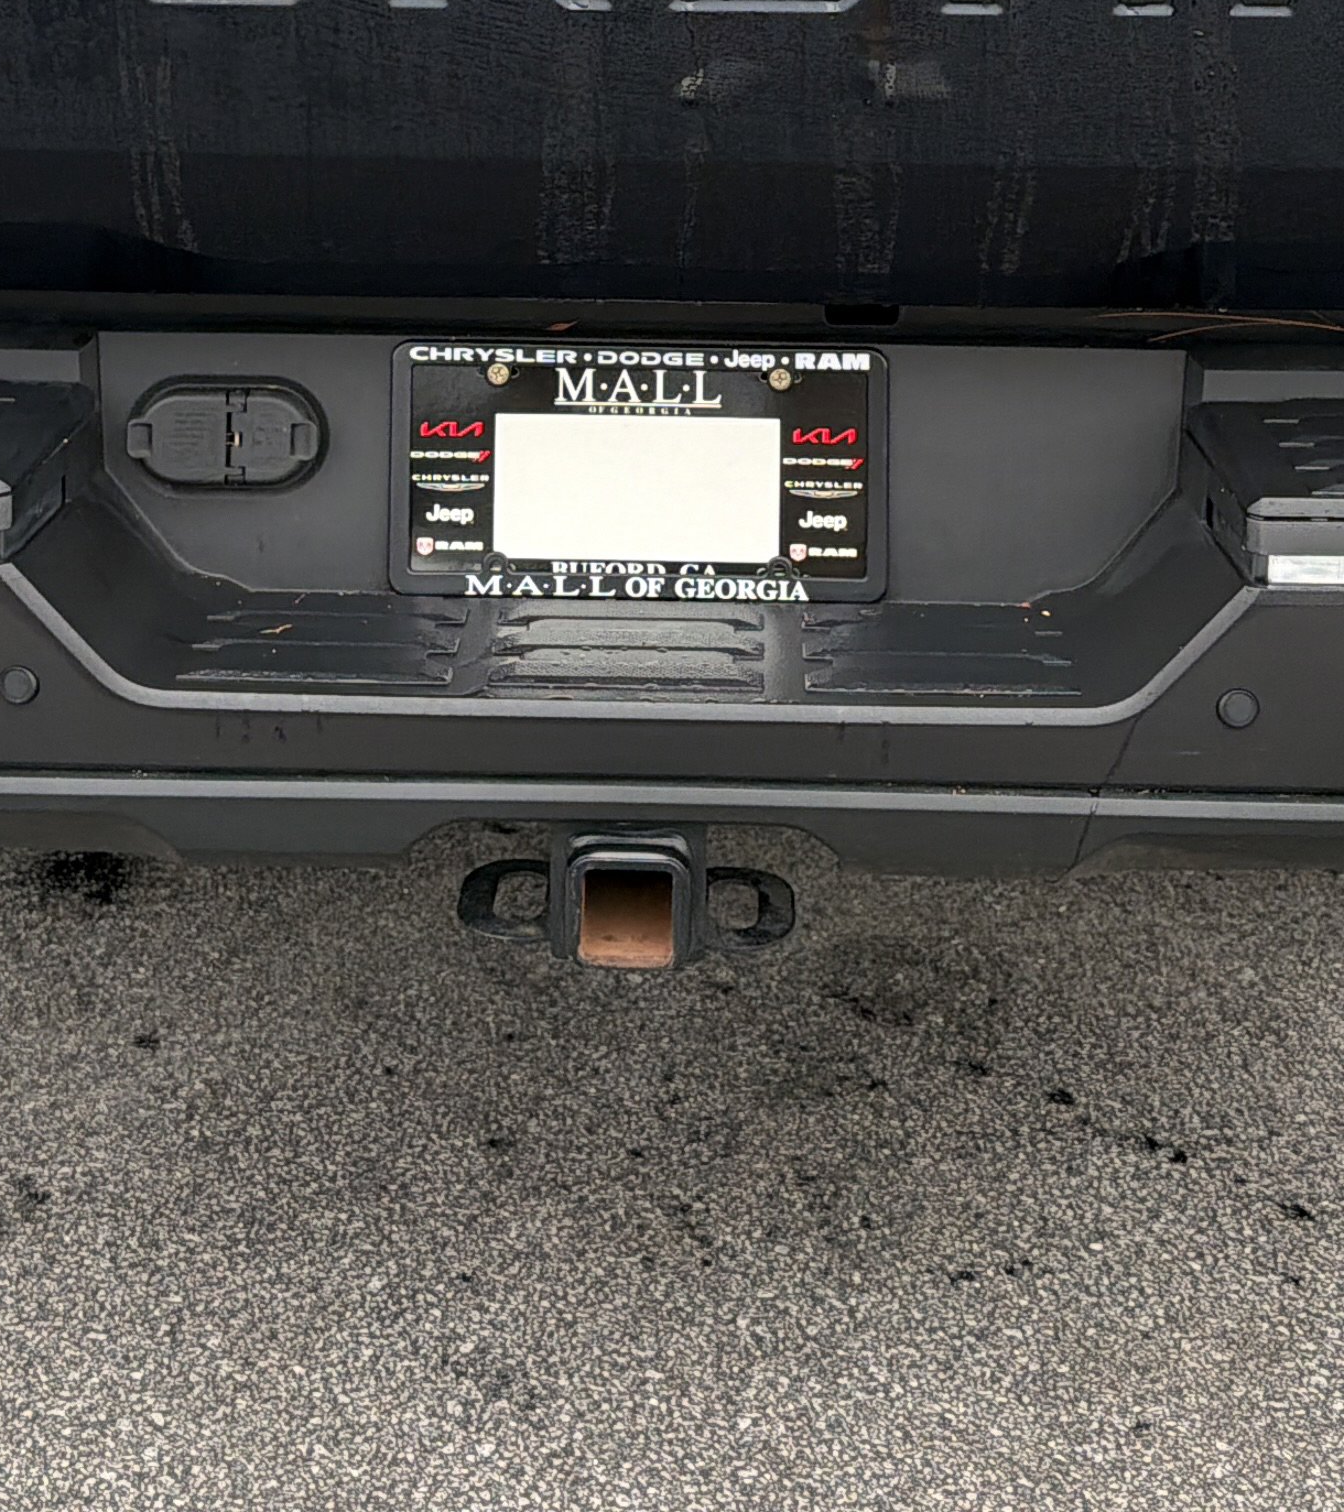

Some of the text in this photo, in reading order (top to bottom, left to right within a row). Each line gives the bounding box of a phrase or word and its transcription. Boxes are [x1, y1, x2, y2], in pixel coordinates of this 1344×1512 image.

[409, 346, 871, 370] CHRYSLER DODGE Jeep RAM
[588, 406, 692, 416] OF GEORGIA
[420, 421, 485, 438] KIA
[792, 428, 857, 445] KIA
[410, 451, 481, 459] DODGE
[782, 457, 854, 466] DODGE
[411, 474, 490, 482] CHRYSLER
[784, 481, 863, 489] CHRYSLER
[425, 503, 474, 525] Jeep
[798, 510, 847, 532] Jeep
[435, 541, 484, 551] RAM
[808, 547, 858, 557] RAM
[625, 575, 666, 598] OF
[674, 578, 810, 602] GEORGIA
